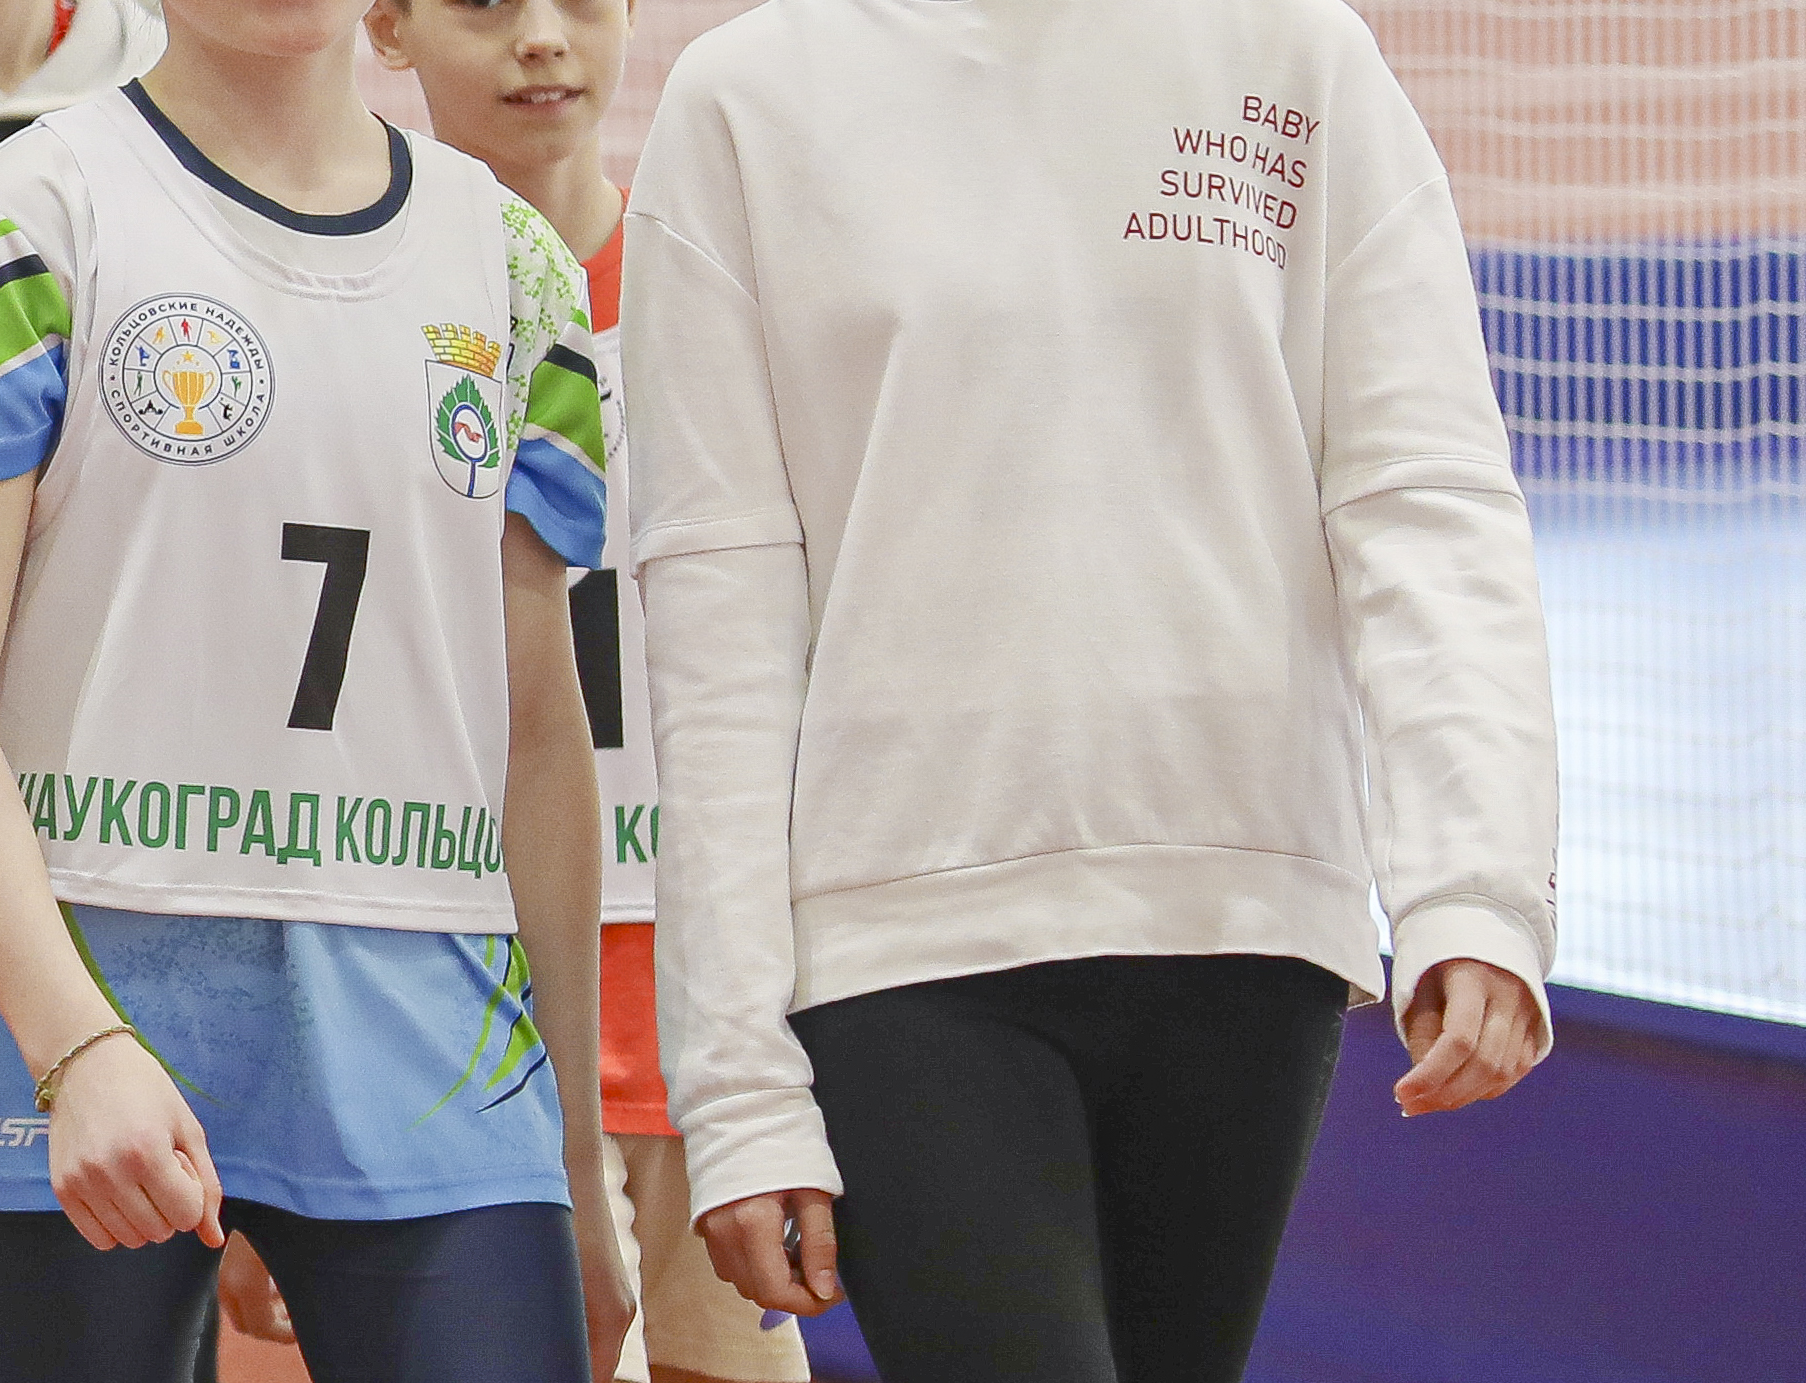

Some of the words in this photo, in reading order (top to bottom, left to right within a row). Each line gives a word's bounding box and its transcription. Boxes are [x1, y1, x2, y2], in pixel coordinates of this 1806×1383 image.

[1242, 95, 1320, 145] BABY
[1173, 127, 1248, 163] WHO
[1251, 142, 1307, 189] HAS
[1160, 169, 1298, 230] SURVIVED
[1123, 212, 1287, 270] ADULTHOOD
[108, 301, 198, 366] КОЛЬЦОВСКИЕ
[205, 305, 265, 370] НАДЕЖДЫ
[110, 389, 213, 456] СПОРТИВНАЯ
[224, 393, 265, 447] ШКОЛА
[281, 522, 371, 732] 7
[335, 795, 507, 879] КОЛЬЦО
